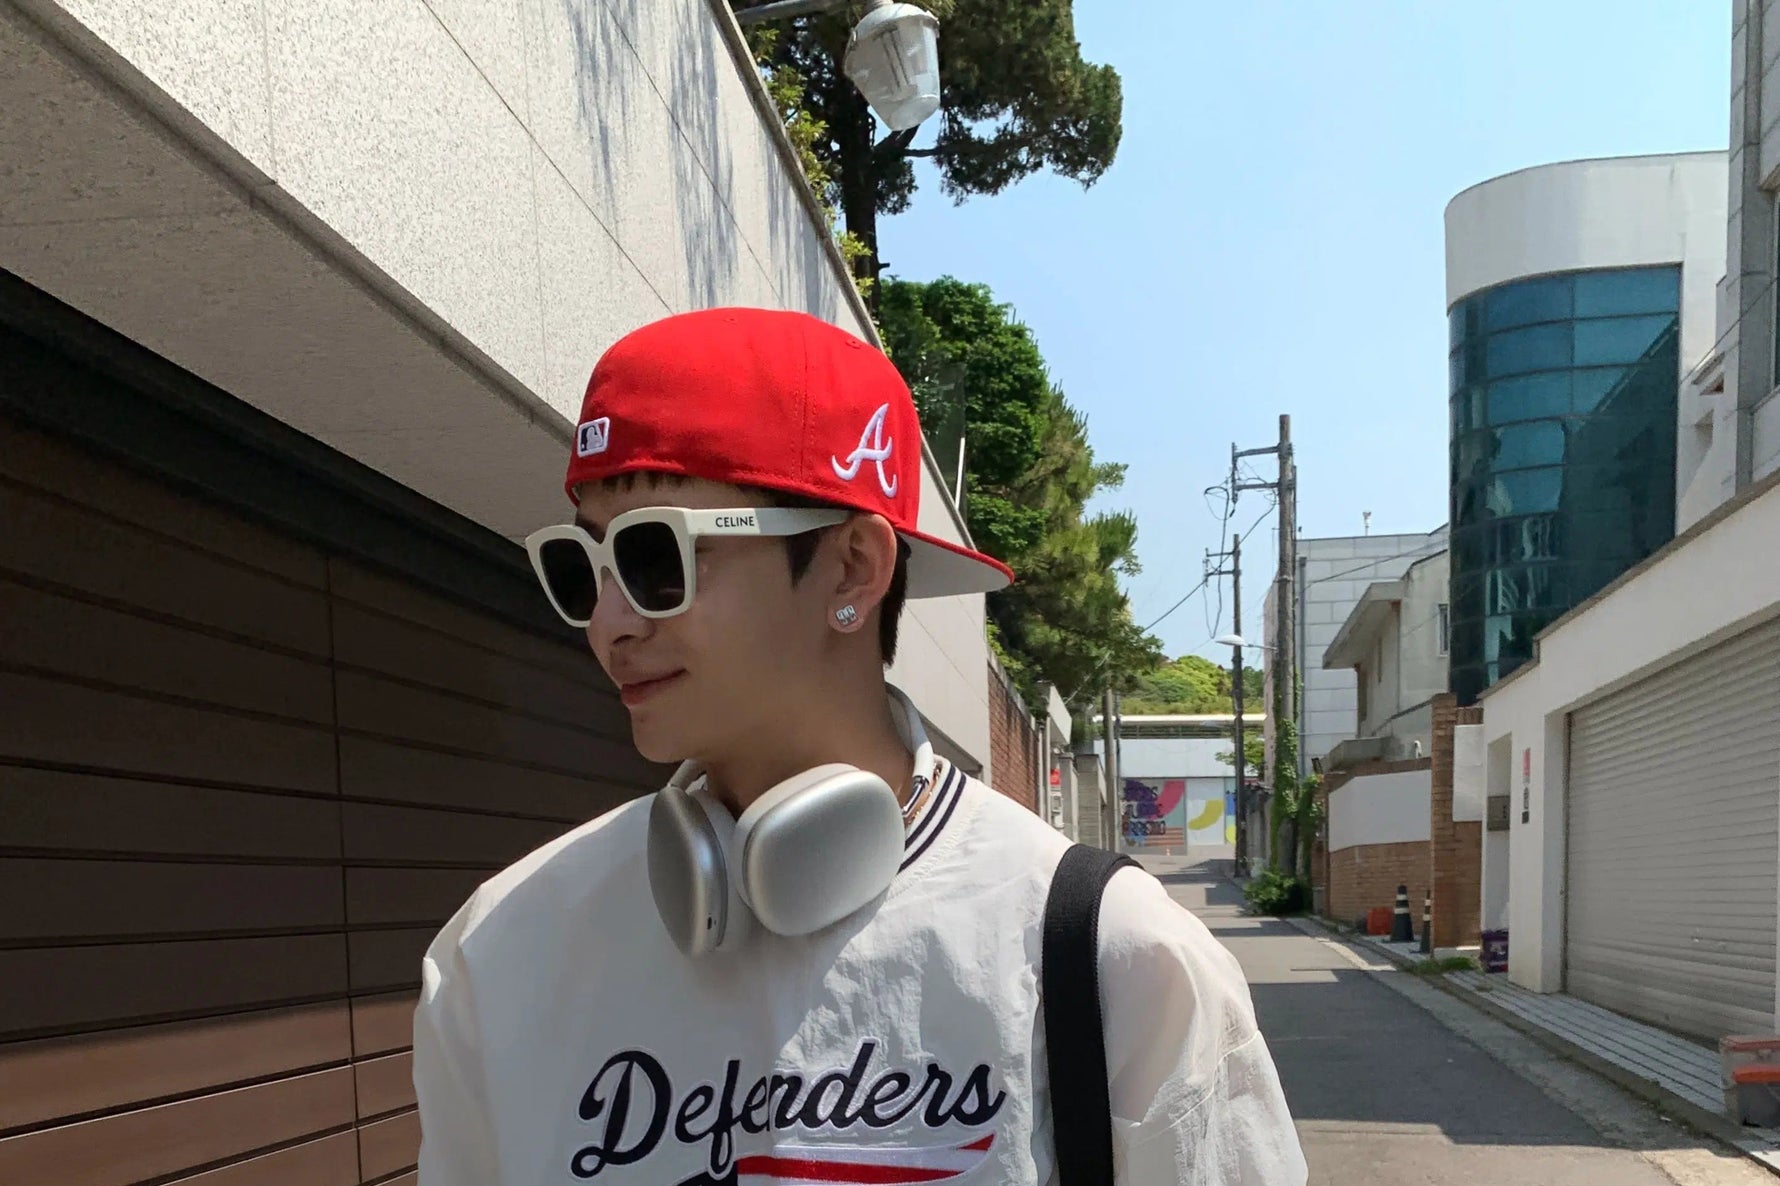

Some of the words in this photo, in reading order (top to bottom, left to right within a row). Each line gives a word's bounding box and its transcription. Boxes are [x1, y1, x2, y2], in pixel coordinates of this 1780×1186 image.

[831, 402, 897, 498] A
[715, 515, 755, 528] CELINE
[569, 1039, 1007, 1179] Defenders
